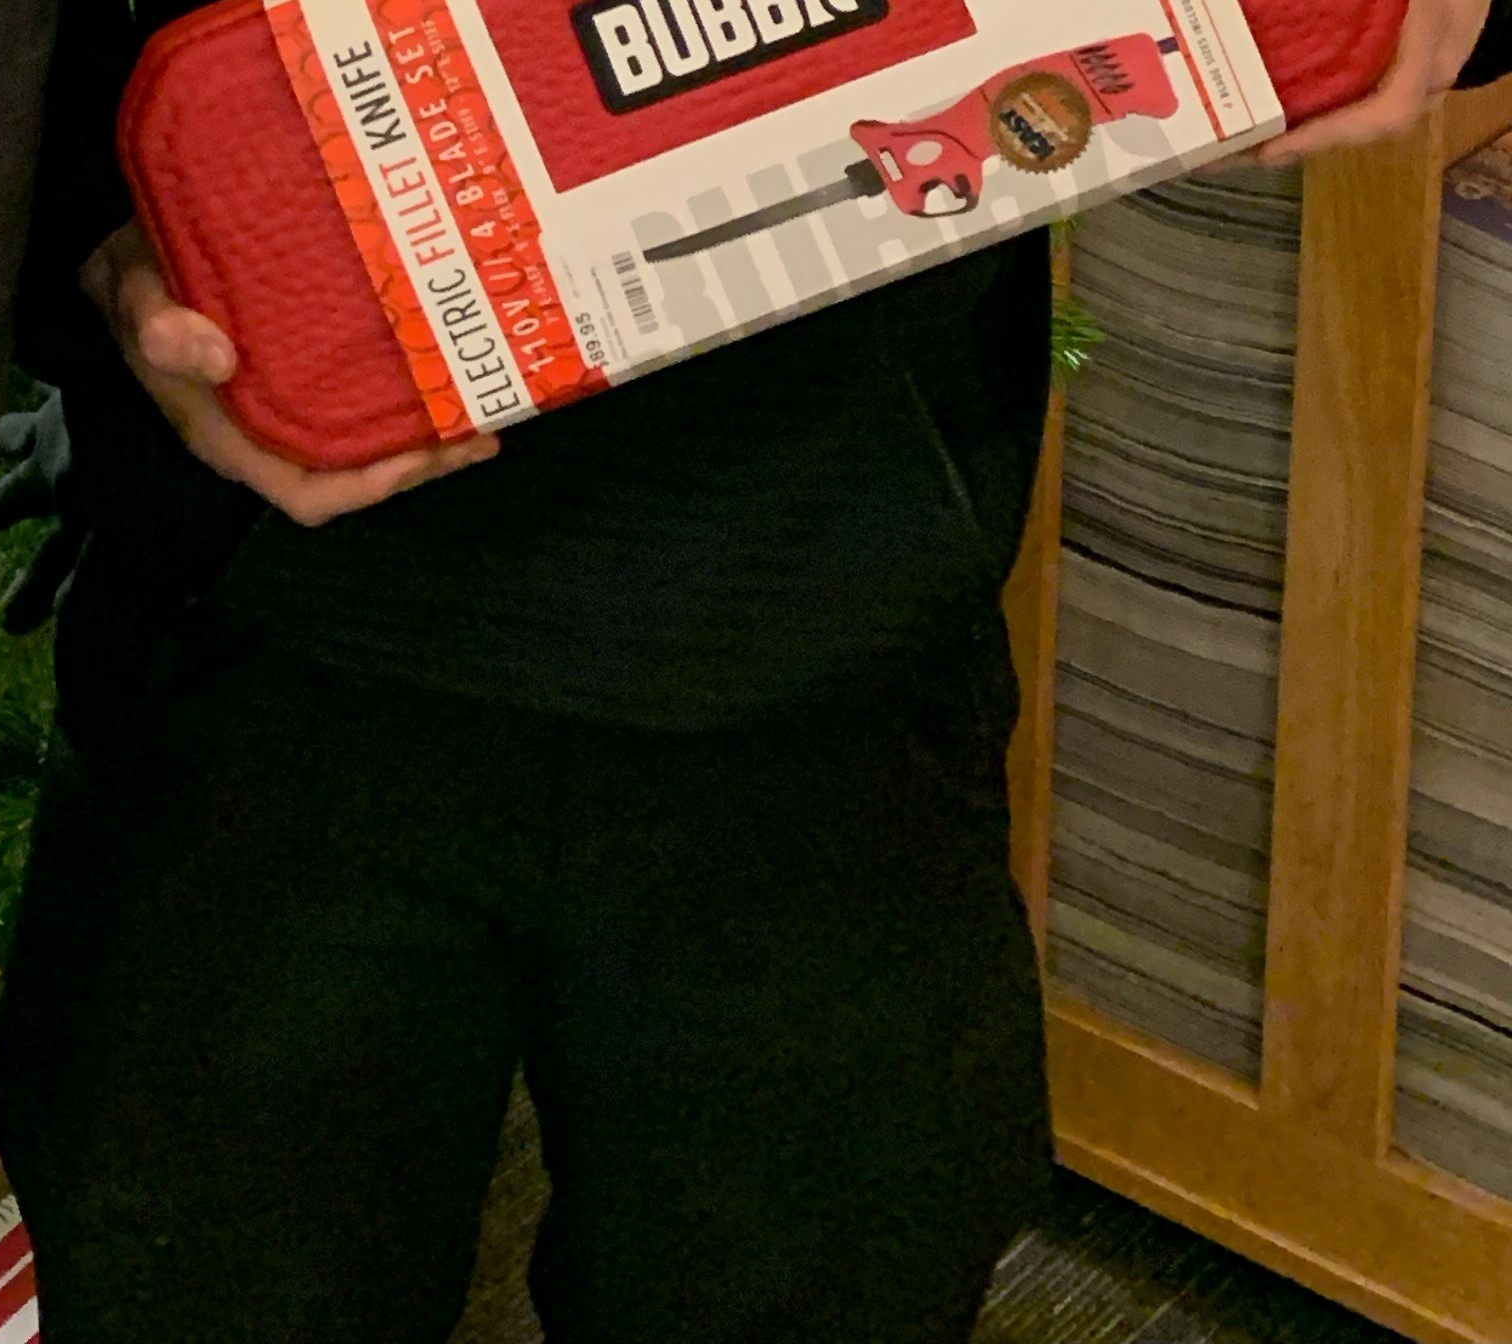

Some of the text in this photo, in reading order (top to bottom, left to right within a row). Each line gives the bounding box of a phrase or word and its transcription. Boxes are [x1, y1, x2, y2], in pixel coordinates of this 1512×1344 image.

[388, 26, 434, 85] SET
[1197, 37, 1215, 66] SIZES
[1209, 68, 1229, 99] BLADE
[419, 96, 484, 206] BLADE
[333, 40, 521, 419] ELECTRIC FILLET KNIFE
[470, 220, 497, 238] 4
[502, 298, 556, 373] 110V
